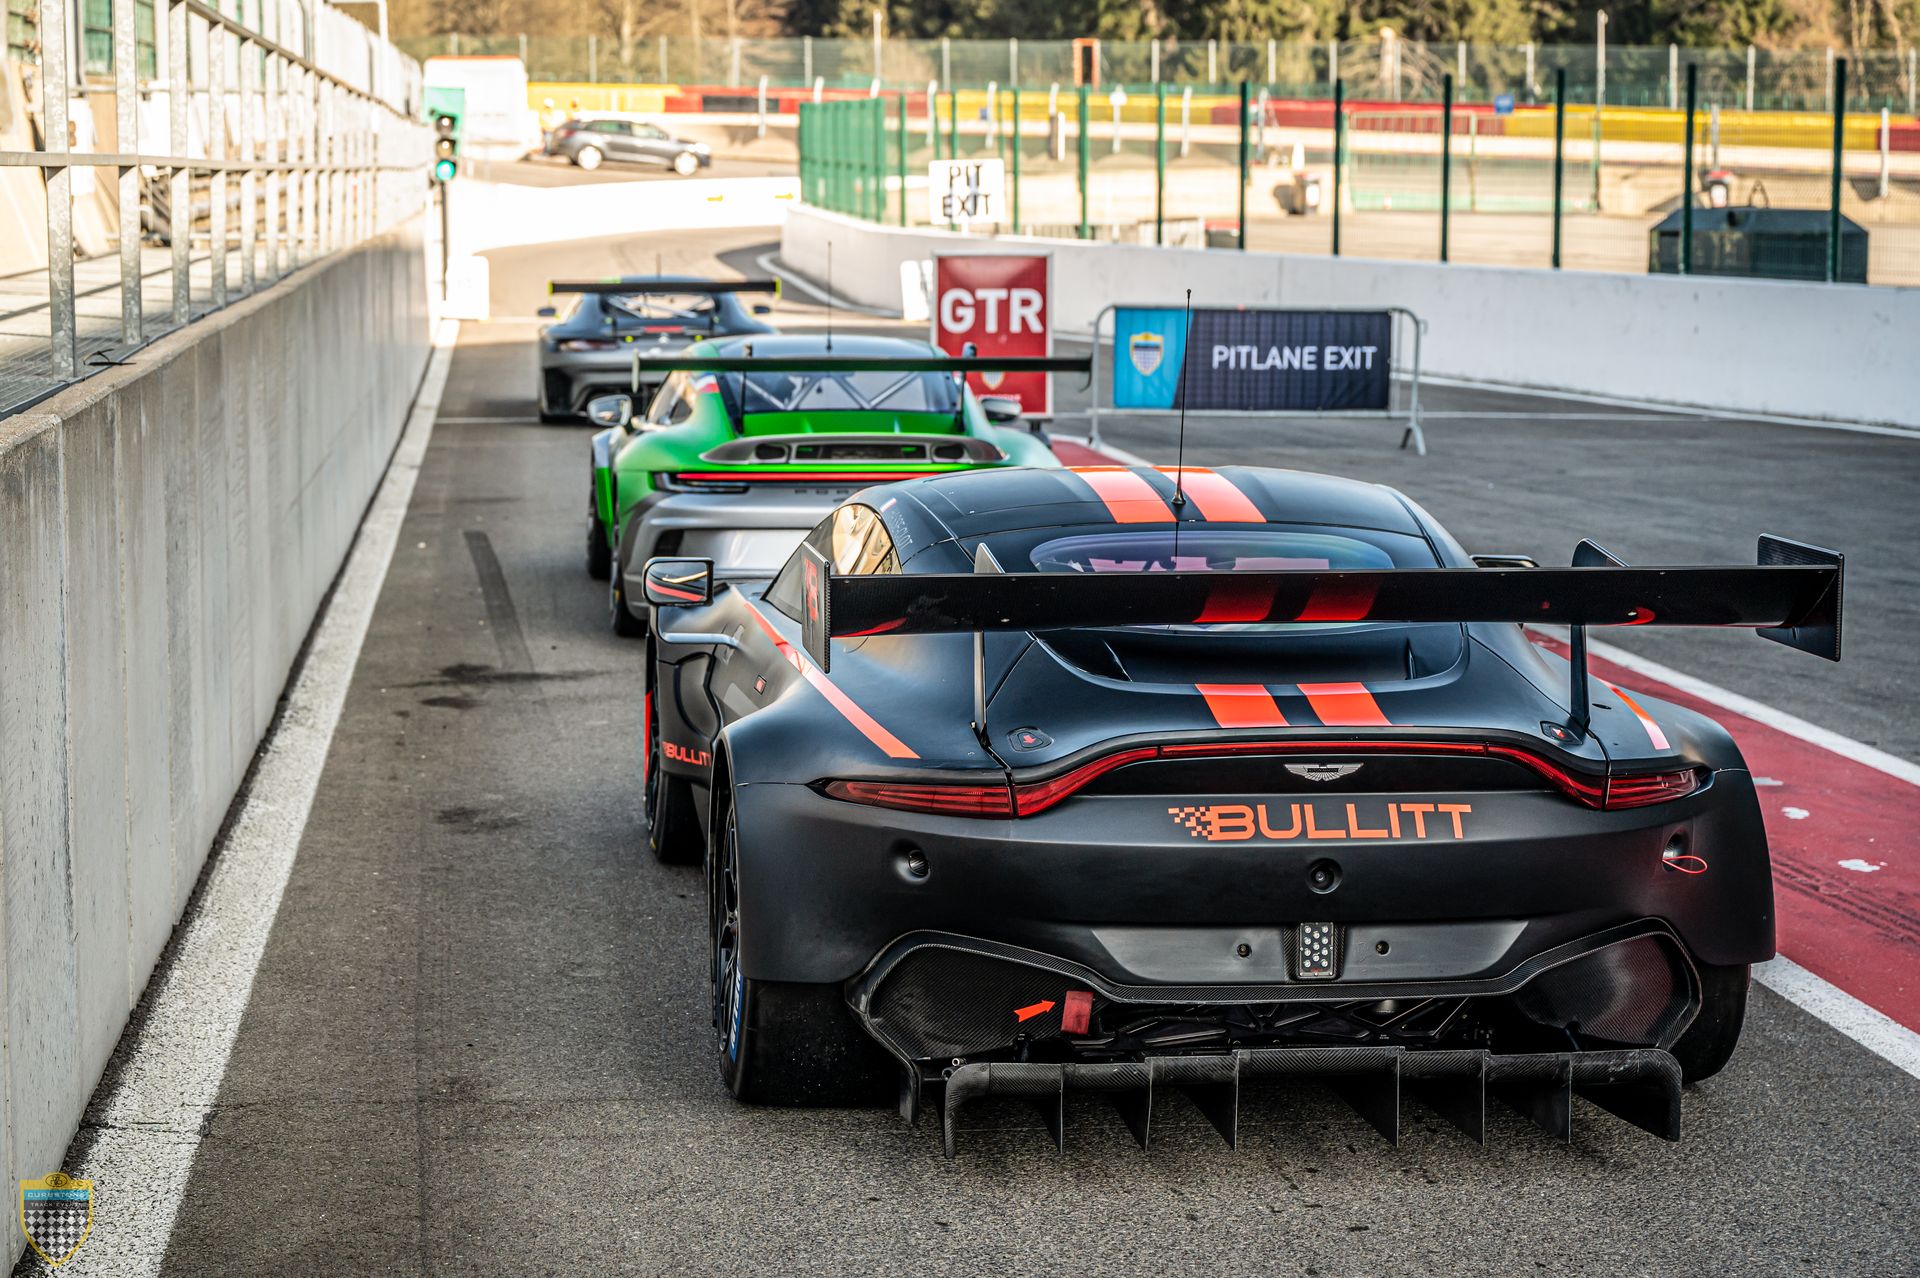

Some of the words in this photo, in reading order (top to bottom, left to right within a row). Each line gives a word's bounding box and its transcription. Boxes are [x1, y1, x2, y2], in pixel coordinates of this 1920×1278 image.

[949, 164, 983, 188] PIT
[942, 192, 991, 217] EXIT
[940, 288, 1044, 334] GTR
[1212, 345, 1318, 370] PITLANE
[1324, 346, 1378, 370] EXIT
[1206, 802, 1473, 841] BULLITT
